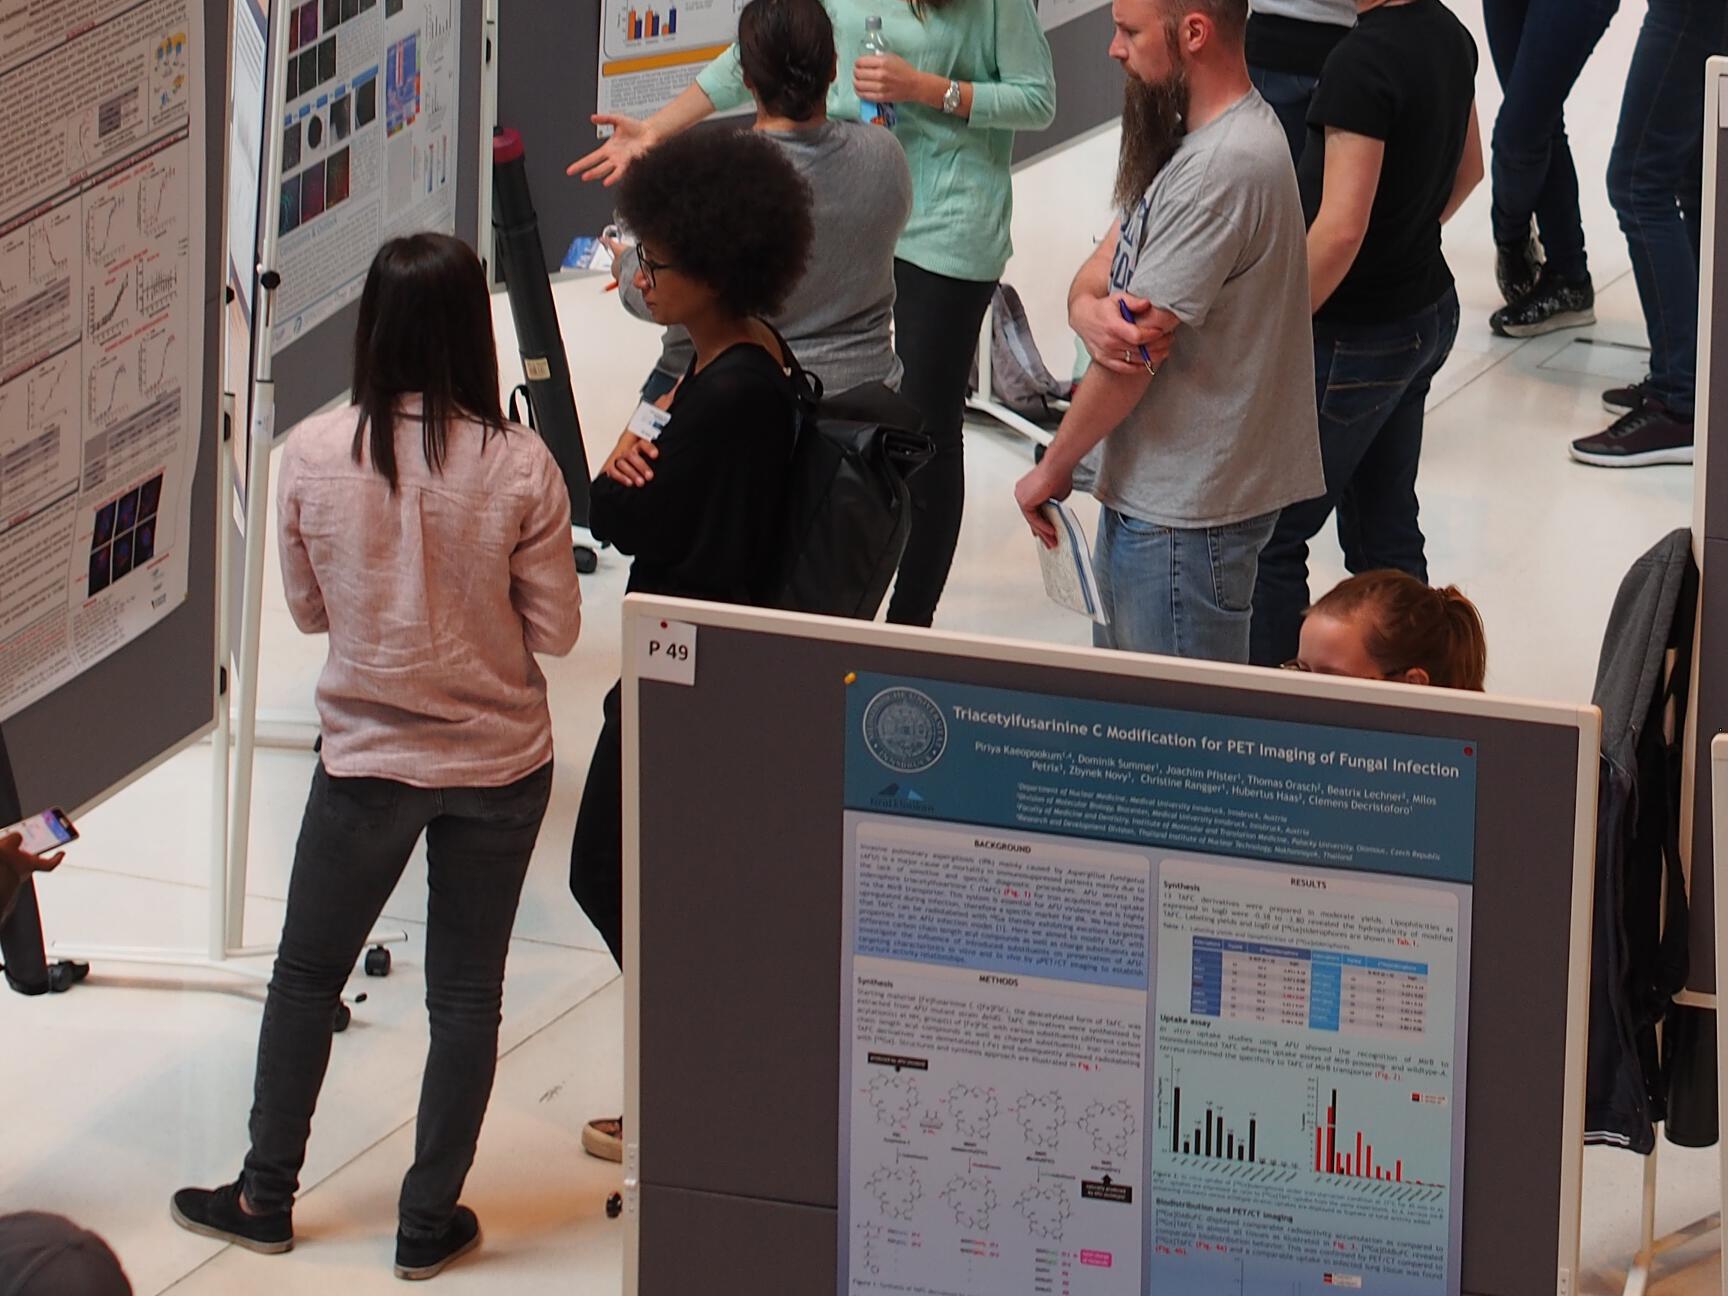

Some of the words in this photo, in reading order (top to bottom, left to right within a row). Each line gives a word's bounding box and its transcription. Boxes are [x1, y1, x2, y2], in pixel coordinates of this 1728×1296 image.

[648, 640, 660, 656] P
[666, 643, 688, 661] 49
[952, 705, 1088, 735] Triacetylfusarinine
[1092, 723, 1102, 737] C
[1106, 725, 1196, 748] Modification
[1201, 736, 1222, 751] for
[1227, 739, 1255, 755] PET
[1260, 743, 1315, 765] Imaging
[1320, 751, 1335, 764] of
[1340, 752, 1387, 772] Fungal
[1393, 758, 1459, 778] Infection
[974, 839, 1031, 854] BACKGROUND
[978, 975, 1018, 987] METHODS
